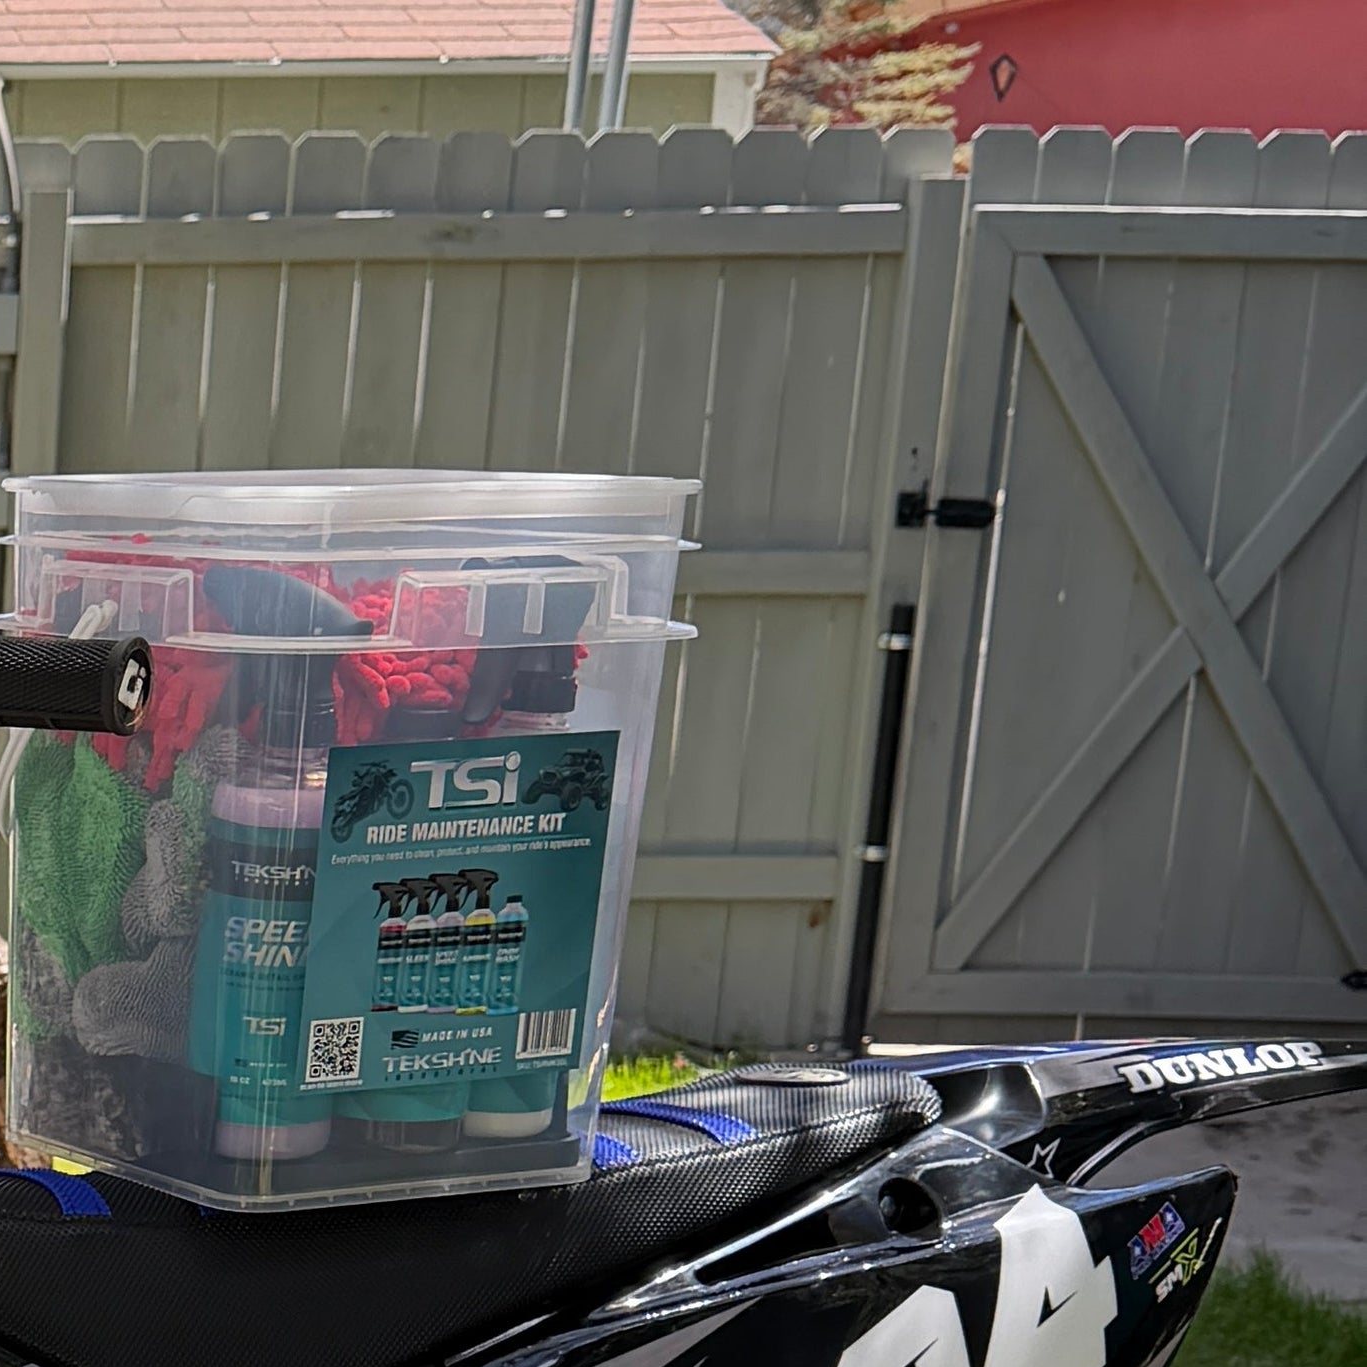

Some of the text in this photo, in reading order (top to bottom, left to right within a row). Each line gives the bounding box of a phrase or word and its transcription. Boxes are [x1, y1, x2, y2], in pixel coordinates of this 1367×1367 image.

[367, 812, 566, 845] RIDE MAINTENANCE KIT
[331, 850, 369, 865] Everything
[371, 852, 385, 863] you
[224, 916, 310, 942] SPEE
[422, 1027, 493, 1043] MADE IN USA
[1118, 1042, 1323, 1094] DUNLOP
